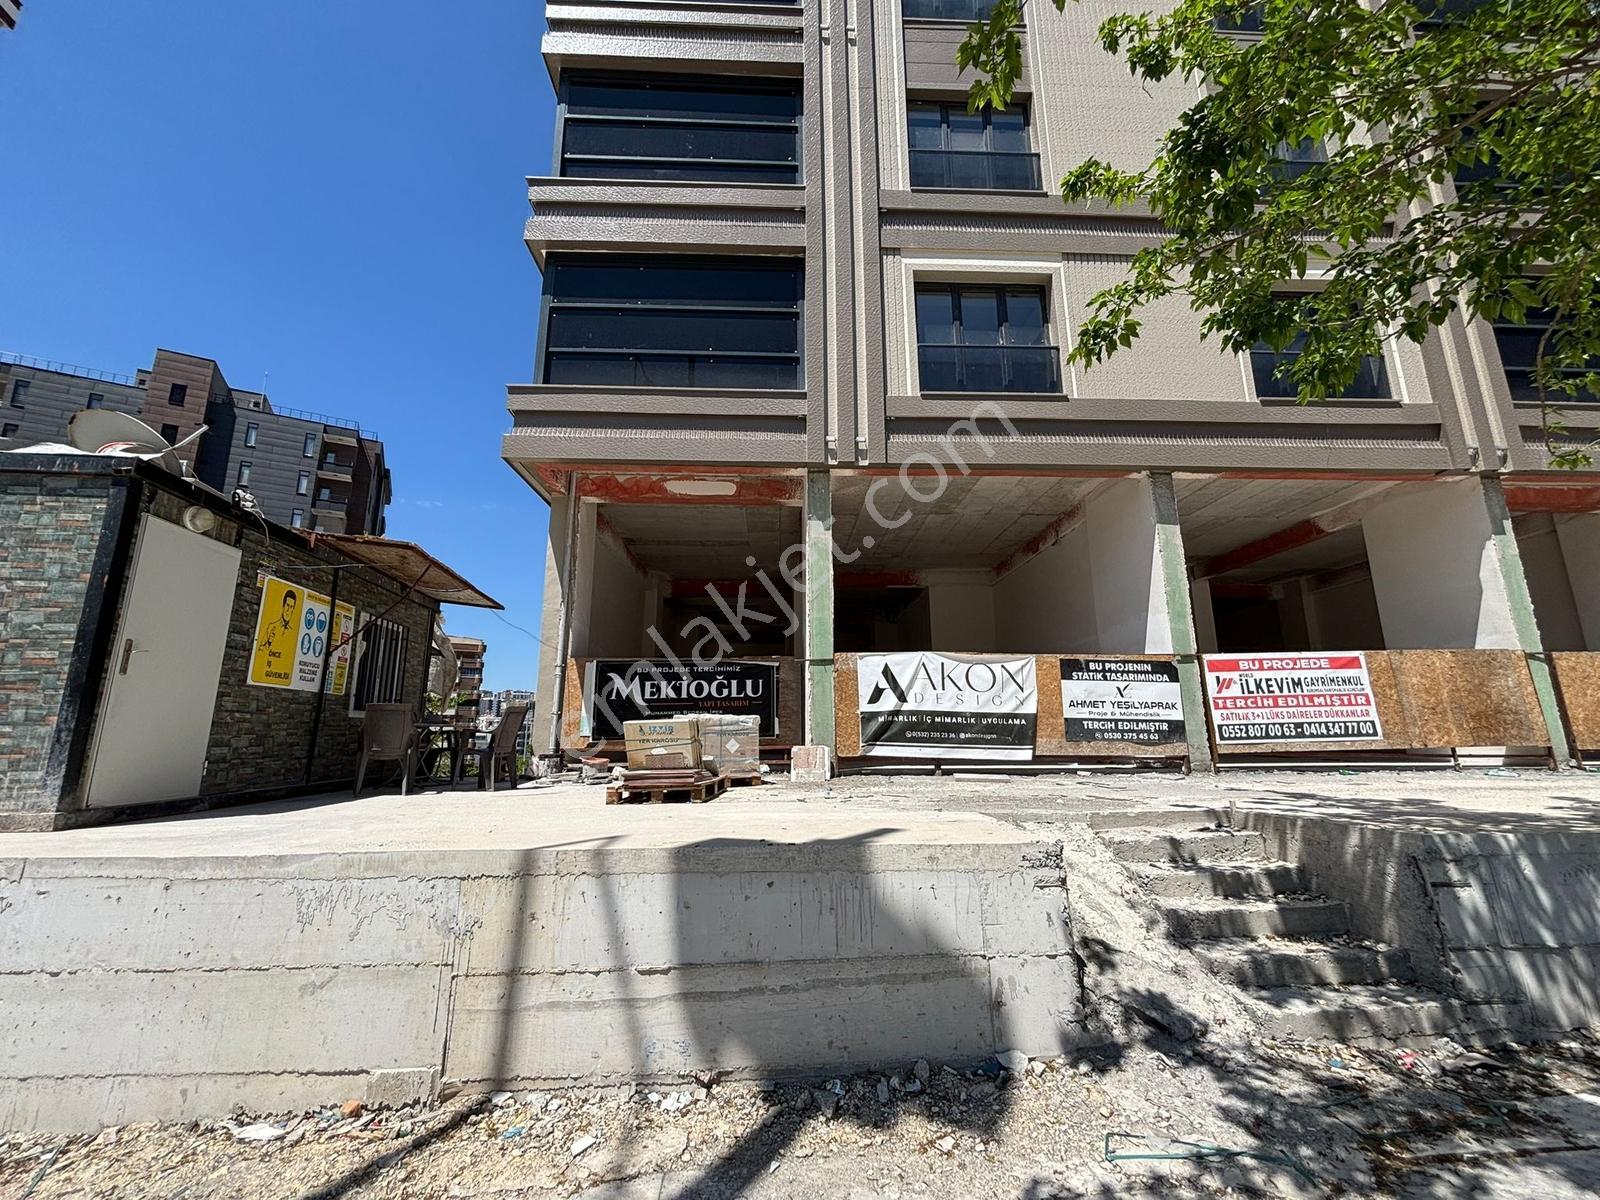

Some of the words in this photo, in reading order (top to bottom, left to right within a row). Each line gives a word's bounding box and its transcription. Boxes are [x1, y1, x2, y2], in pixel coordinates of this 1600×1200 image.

[651, 666, 690, 674] PROJEDE
[1089, 662, 1103, 670] BU
[1105, 662, 1151, 672] PROJENİN
[1239, 661, 1260, 670] BU
[1263, 658, 1331, 669] PROJEDE
[915, 661, 1025, 693] AKON
[1072, 672, 1104, 681] STATİK
[1105, 673, 1170, 682] TASARIMINDA
[1240, 677, 1304, 695] İLKEVİM
[1304, 674, 1364, 687] GAYRİMENKUL
[914, 692, 1025, 706] DESIGN
[1215, 698, 1274, 708] TERCİH
[1278, 695, 1367, 707] EDİLMİŞTİR
[1068, 700, 1107, 709] AHMET
[1110, 701, 1178, 711] YEŞİLYAPRAK
[923, 715, 932, 723] İÇ
[935, 716, 976, 724] MİMARLIK
[1251, 711, 1265, 720] 3+1
[1266, 709, 1286, 719] LÜKS
[1287, 708, 1324, 719] DAİRELER
[1325, 707, 1371, 718] DÜKKANLAR
[1082, 721, 1116, 730] TERCİH
[1118, 721, 1169, 732] EDİLMİŞTİR
[1222, 726, 1247, 737] 0552
[1249, 725, 1266, 737] 807
[1269, 724, 1281, 736] 00
[1284, 724, 1296, 736] 63
[1304, 723, 1327, 735] 0414
[1328, 723, 1345, 735] 347
[1346, 722, 1358, 734] 77
[1359, 722, 1374, 734] 00
